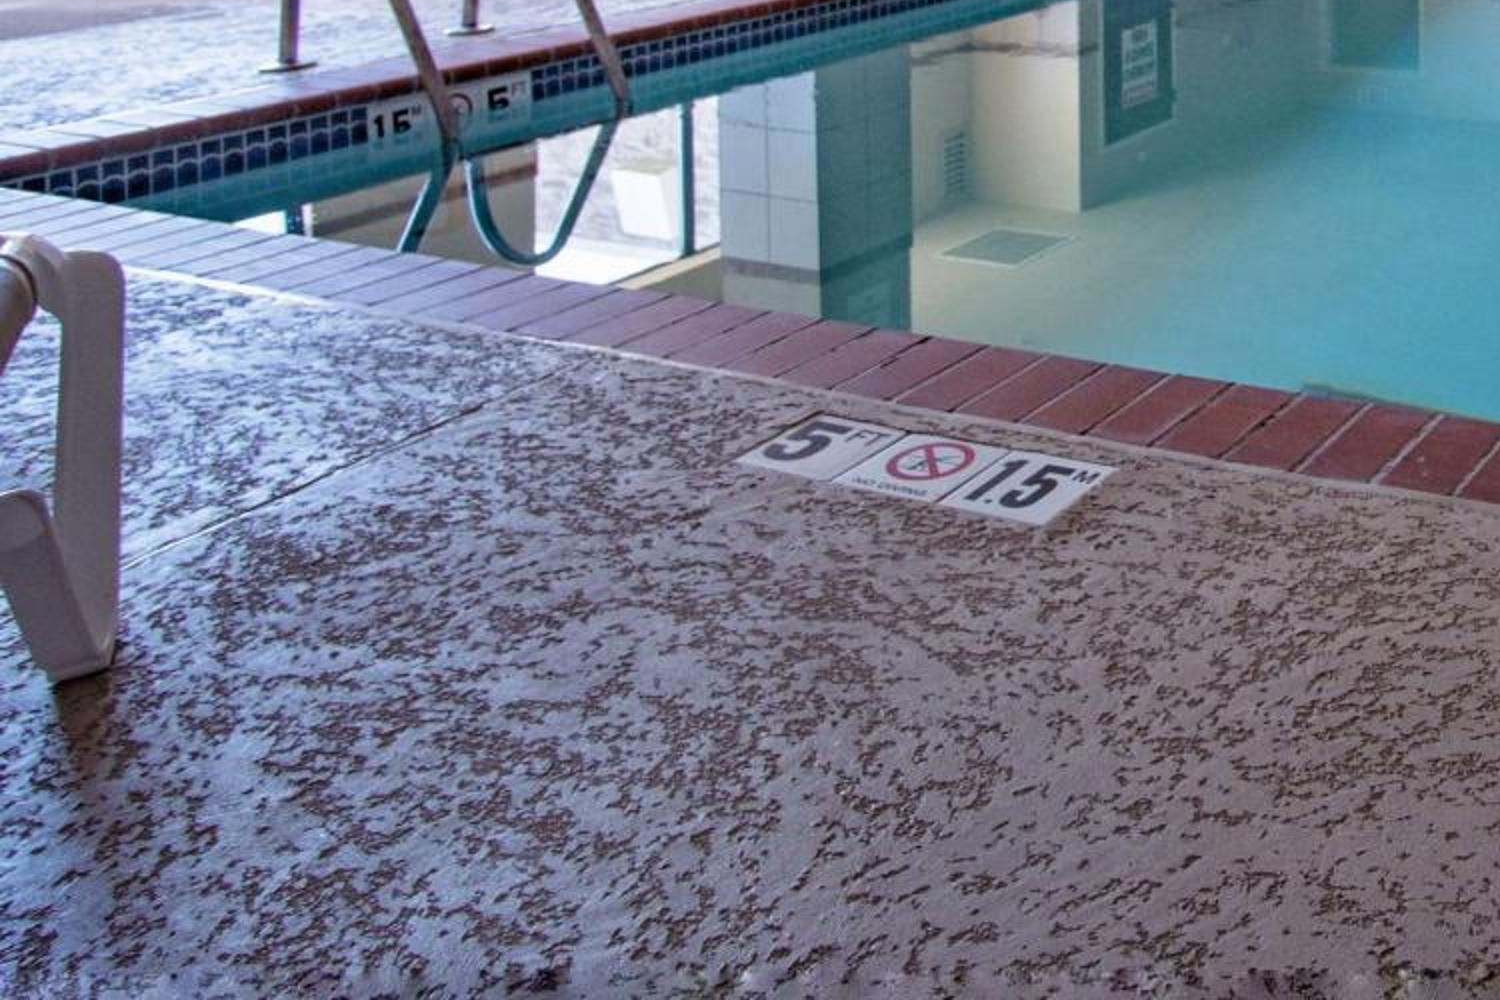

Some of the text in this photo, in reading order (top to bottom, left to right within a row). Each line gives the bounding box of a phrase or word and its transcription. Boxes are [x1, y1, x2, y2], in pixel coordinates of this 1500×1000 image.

[487, 86, 510, 110] 5
[763, 421, 896, 462] 5 FT
[964, 458, 1101, 509] 1.5 M
